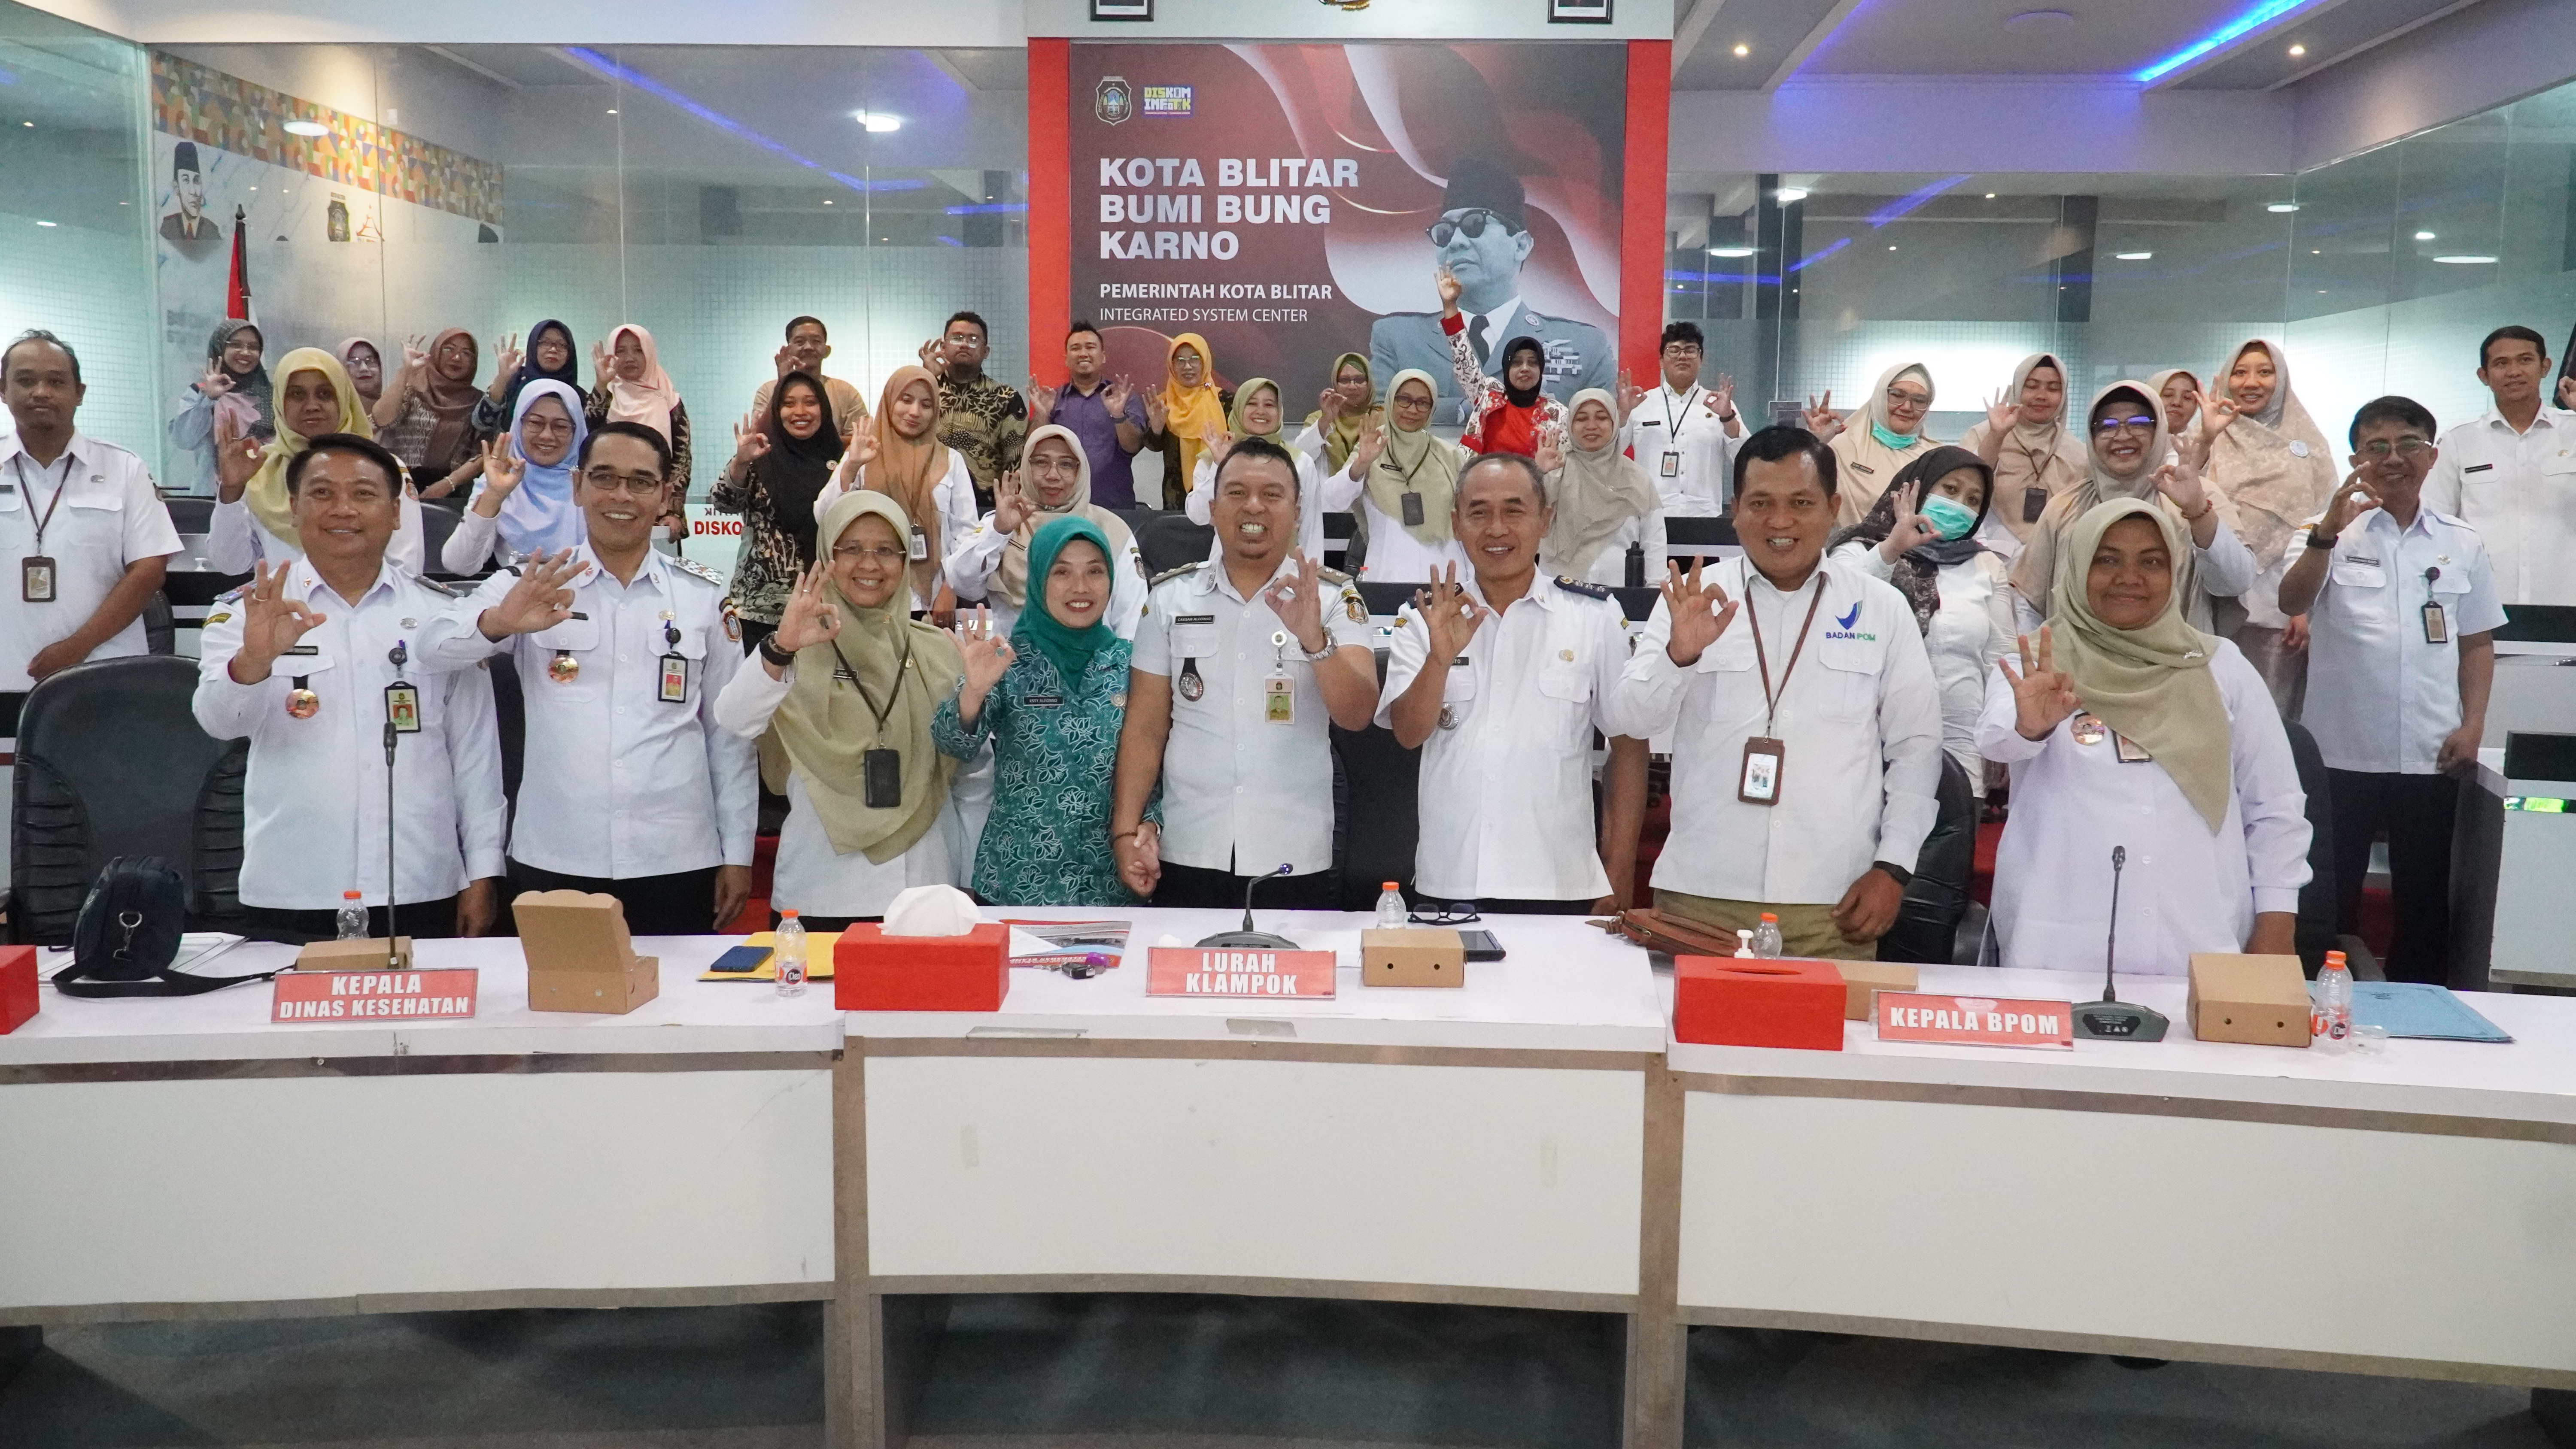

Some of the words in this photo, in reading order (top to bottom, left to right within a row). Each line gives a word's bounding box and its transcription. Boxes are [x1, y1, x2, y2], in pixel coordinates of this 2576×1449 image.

[1144, 87, 1191, 98] DISKOM
[1100, 158, 1204, 187] KOTA
[1218, 159, 1358, 187] BLITAR
[1100, 195, 1202, 223] BUMI
[1217, 195, 1331, 224] BUNG
[1100, 231, 1239, 260] KARNO
[1100, 284, 1215, 299] PEMERINTAH
[1220, 284, 1266, 299] KOTA
[1271, 285, 1332, 299] BLITAR
[1100, 308, 1189, 322] INTEGRATED
[1193, 308, 1249, 321] SYSTEM
[1252, 309, 1308, 321] CENTER
[695, 521, 742, 535] DISKO
[1202, 953, 1276, 973] LURAH
[331, 975, 421, 995] KEPALA
[788, 972, 801, 981] Cleo
[1186, 973, 1297, 994] KLAMPOK
[279, 1000, 344, 1018] DINAS
[352, 997, 468, 1016] KESEHATAN
[1890, 1007, 1980, 1031] KEPALA
[1987, 1012, 2059, 1035] BPOM
